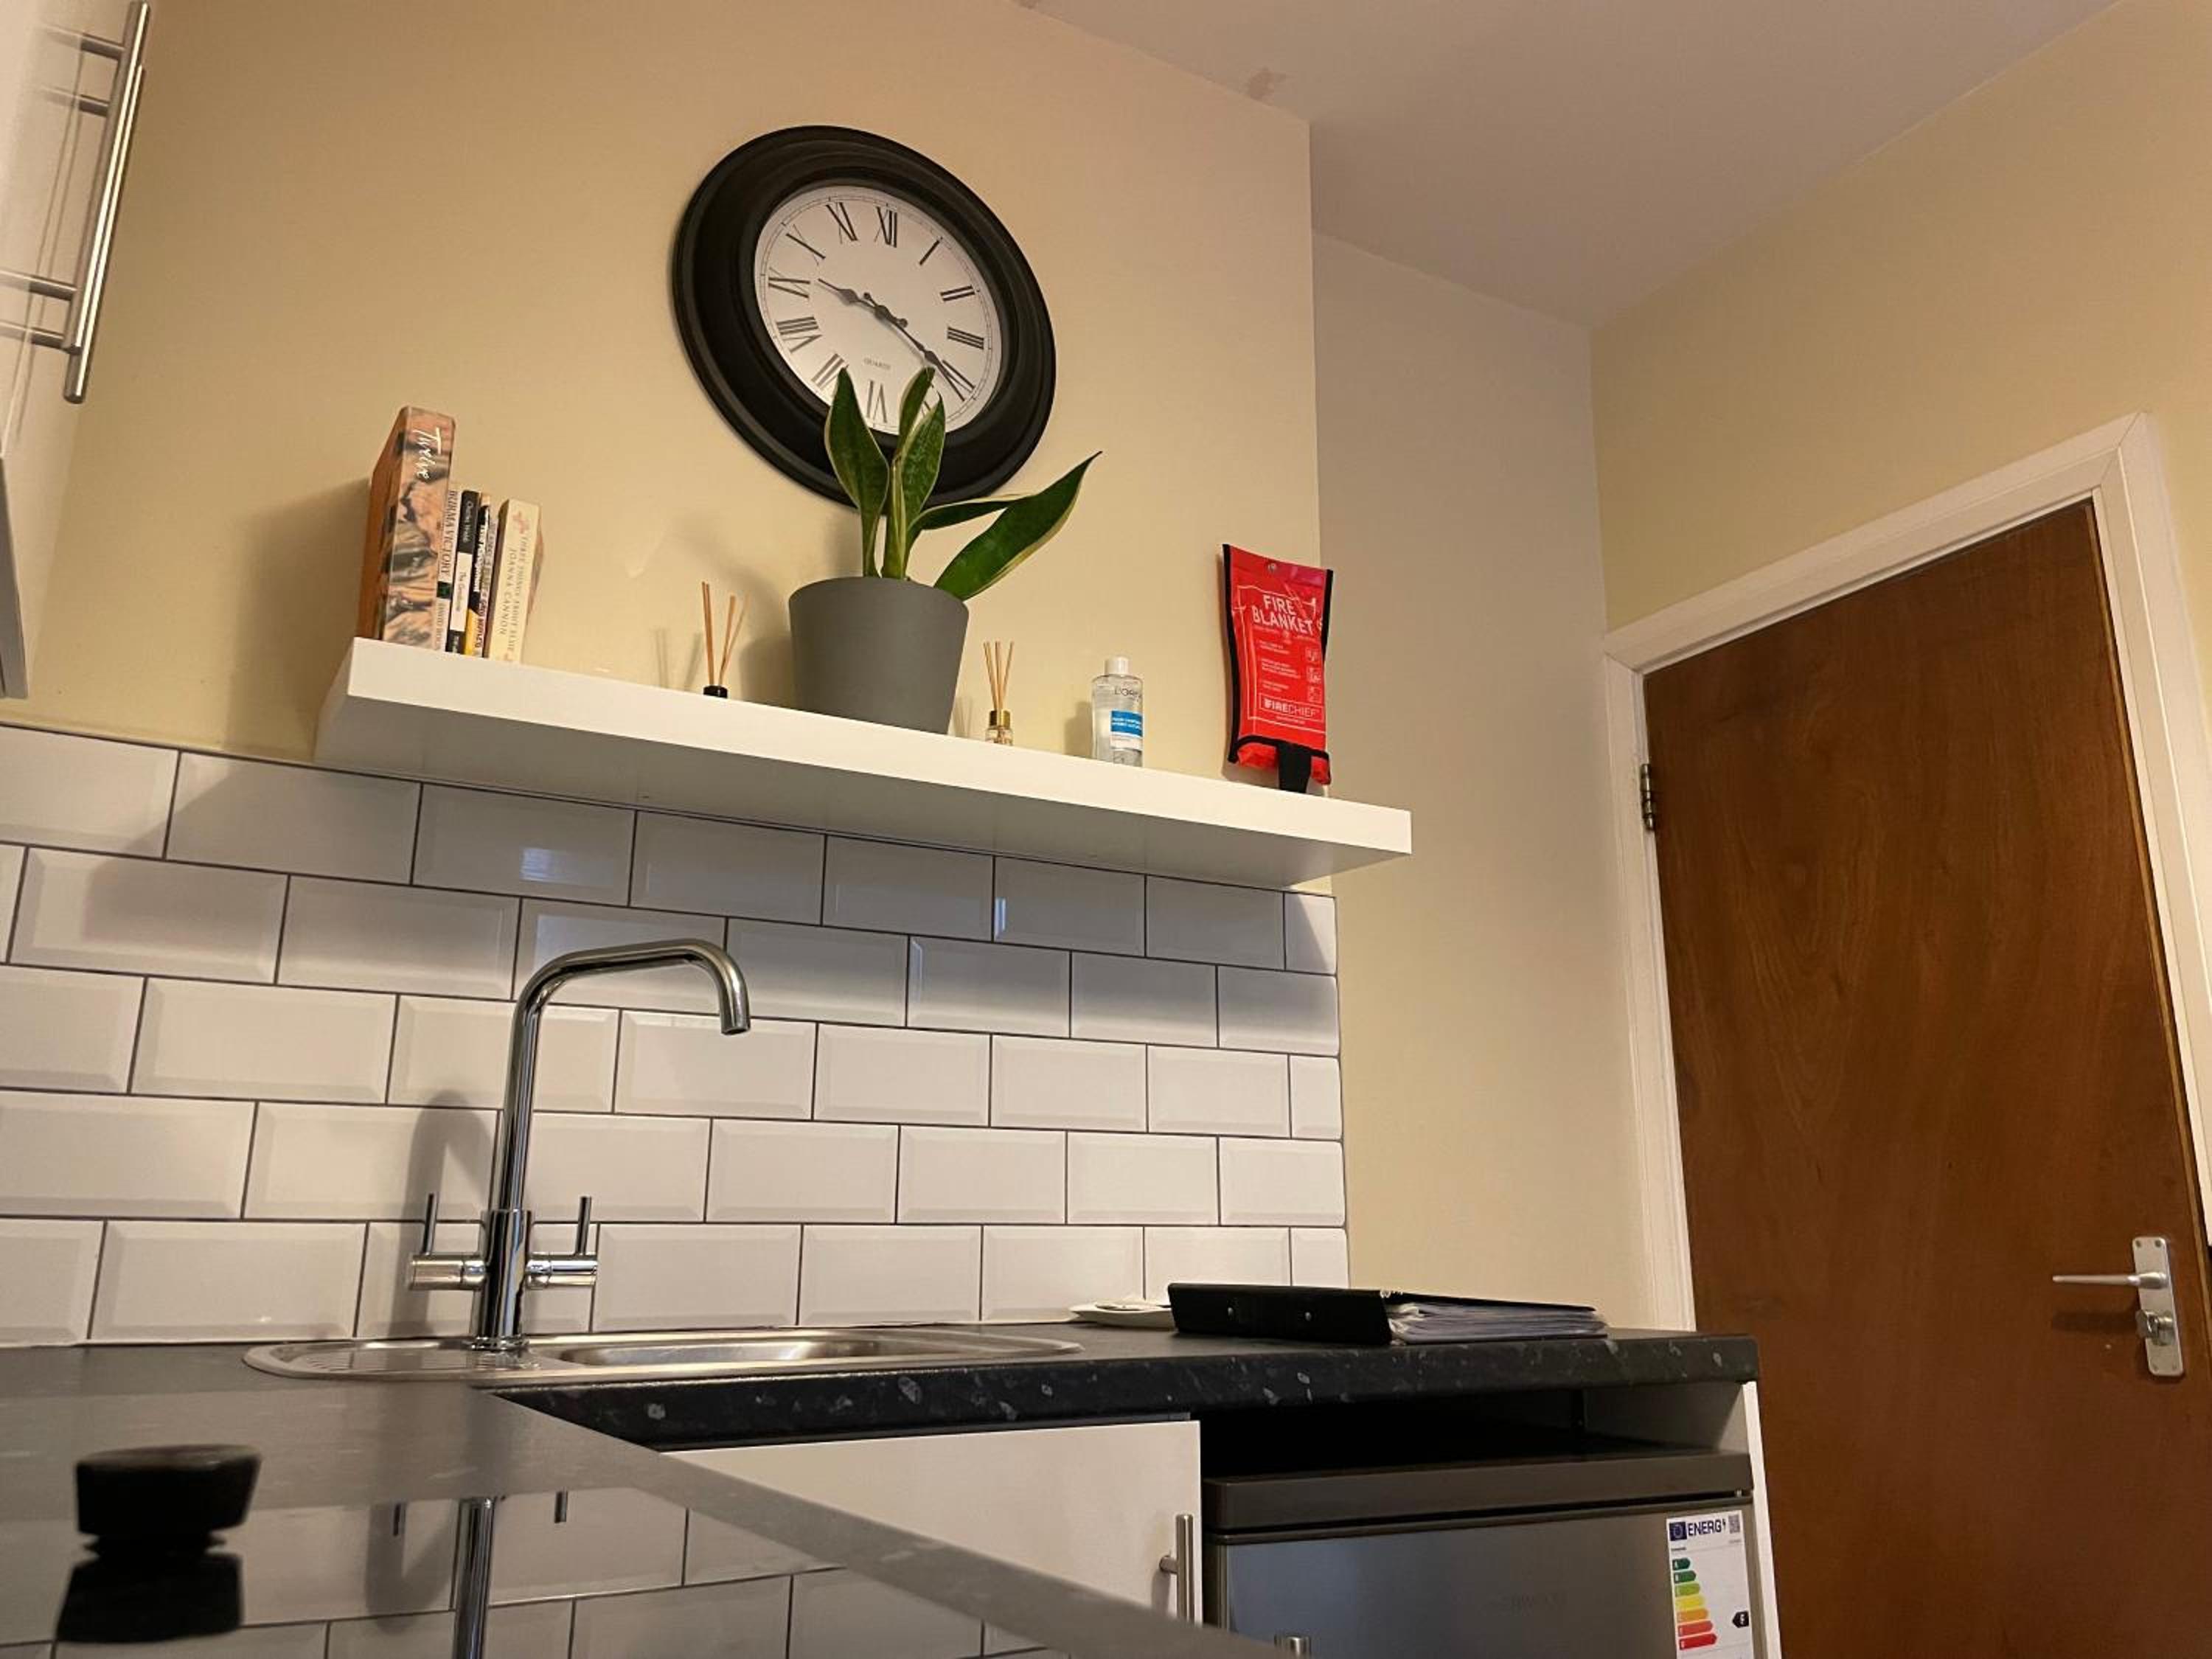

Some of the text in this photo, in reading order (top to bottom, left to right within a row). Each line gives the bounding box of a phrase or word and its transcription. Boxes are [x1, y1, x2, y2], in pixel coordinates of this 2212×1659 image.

[825, 201, 858, 245] XI
[873, 206, 897, 248] XII
[1251, 605, 1313, 636] BLANKET
[1263, 594, 1296, 615] FIRE
